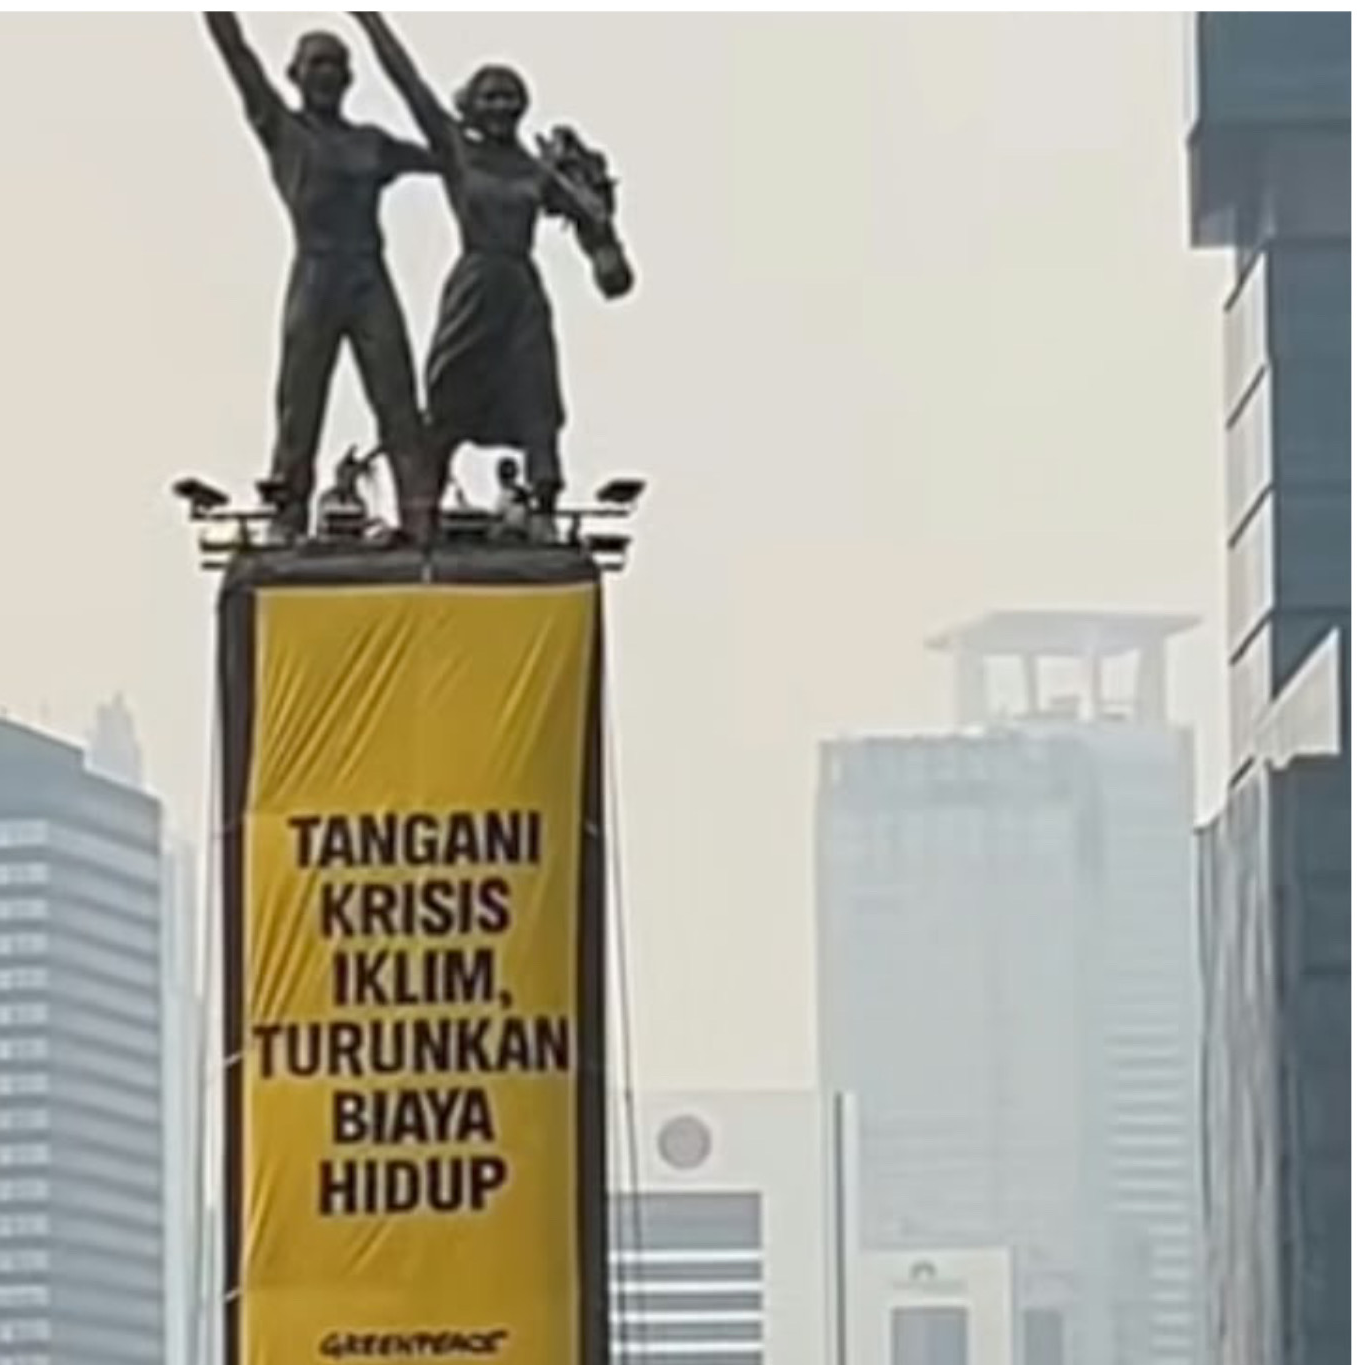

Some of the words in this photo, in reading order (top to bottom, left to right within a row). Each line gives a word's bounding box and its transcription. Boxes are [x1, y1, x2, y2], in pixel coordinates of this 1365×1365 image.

[286, 812, 541, 868] TANGANI
[321, 878, 510, 937] KRISIS
[333, 949, 514, 1008] IKLIM,
[254, 1018, 570, 1079] TURUNKAN
[332, 1089, 495, 1145] BIAYA
[319, 1159, 508, 1215] HIDUP
[318, 1328, 508, 1359] GREENPEACE
